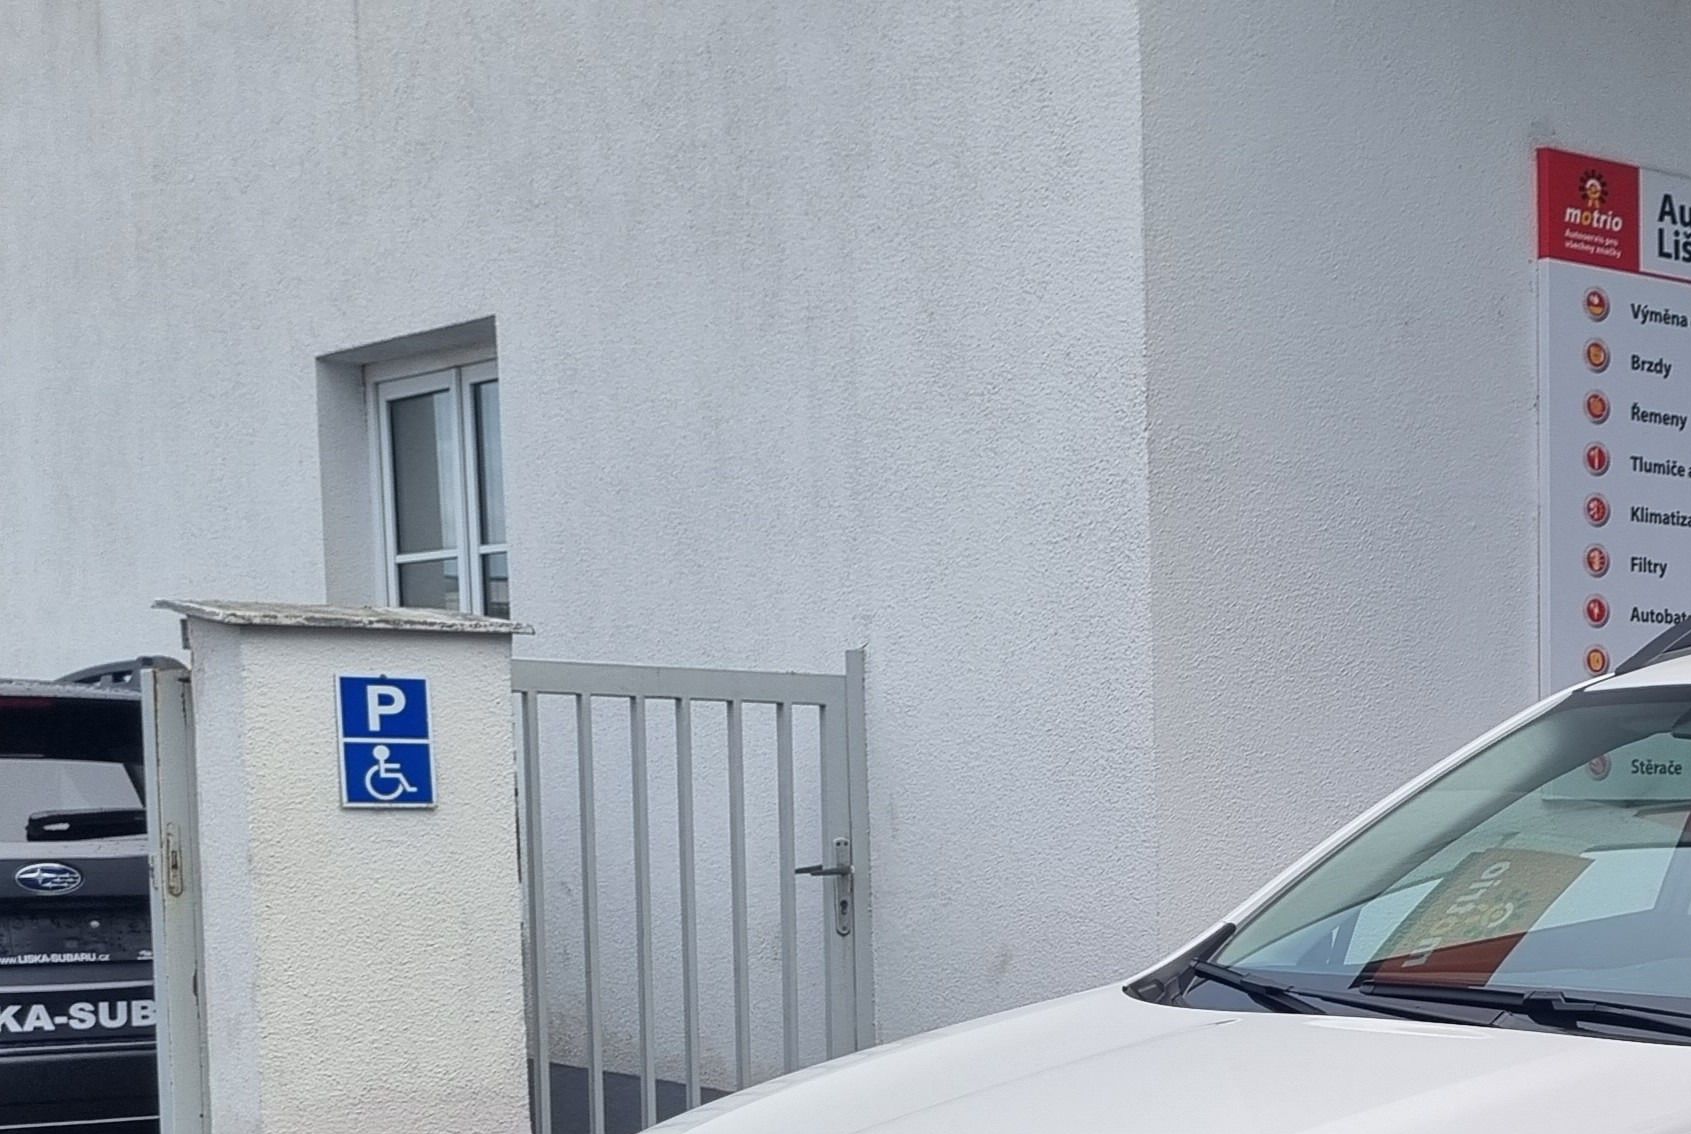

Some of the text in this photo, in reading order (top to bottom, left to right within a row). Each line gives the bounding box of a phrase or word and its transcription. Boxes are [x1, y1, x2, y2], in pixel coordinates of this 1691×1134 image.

[1564, 206, 1623, 232] motrio
[1630, 302, 1688, 329] Výměna
[1631, 354, 1672, 379] Brzdy
[1631, 401, 1688, 432] Řemeny
[1630, 455, 1686, 478] Tlumiče
[1630, 557, 1668, 578] Filtry
[1630, 606, 1691, 625] Autobat
[366, 685, 406, 732] P
[1631, 758, 1682, 775] Stěrače
